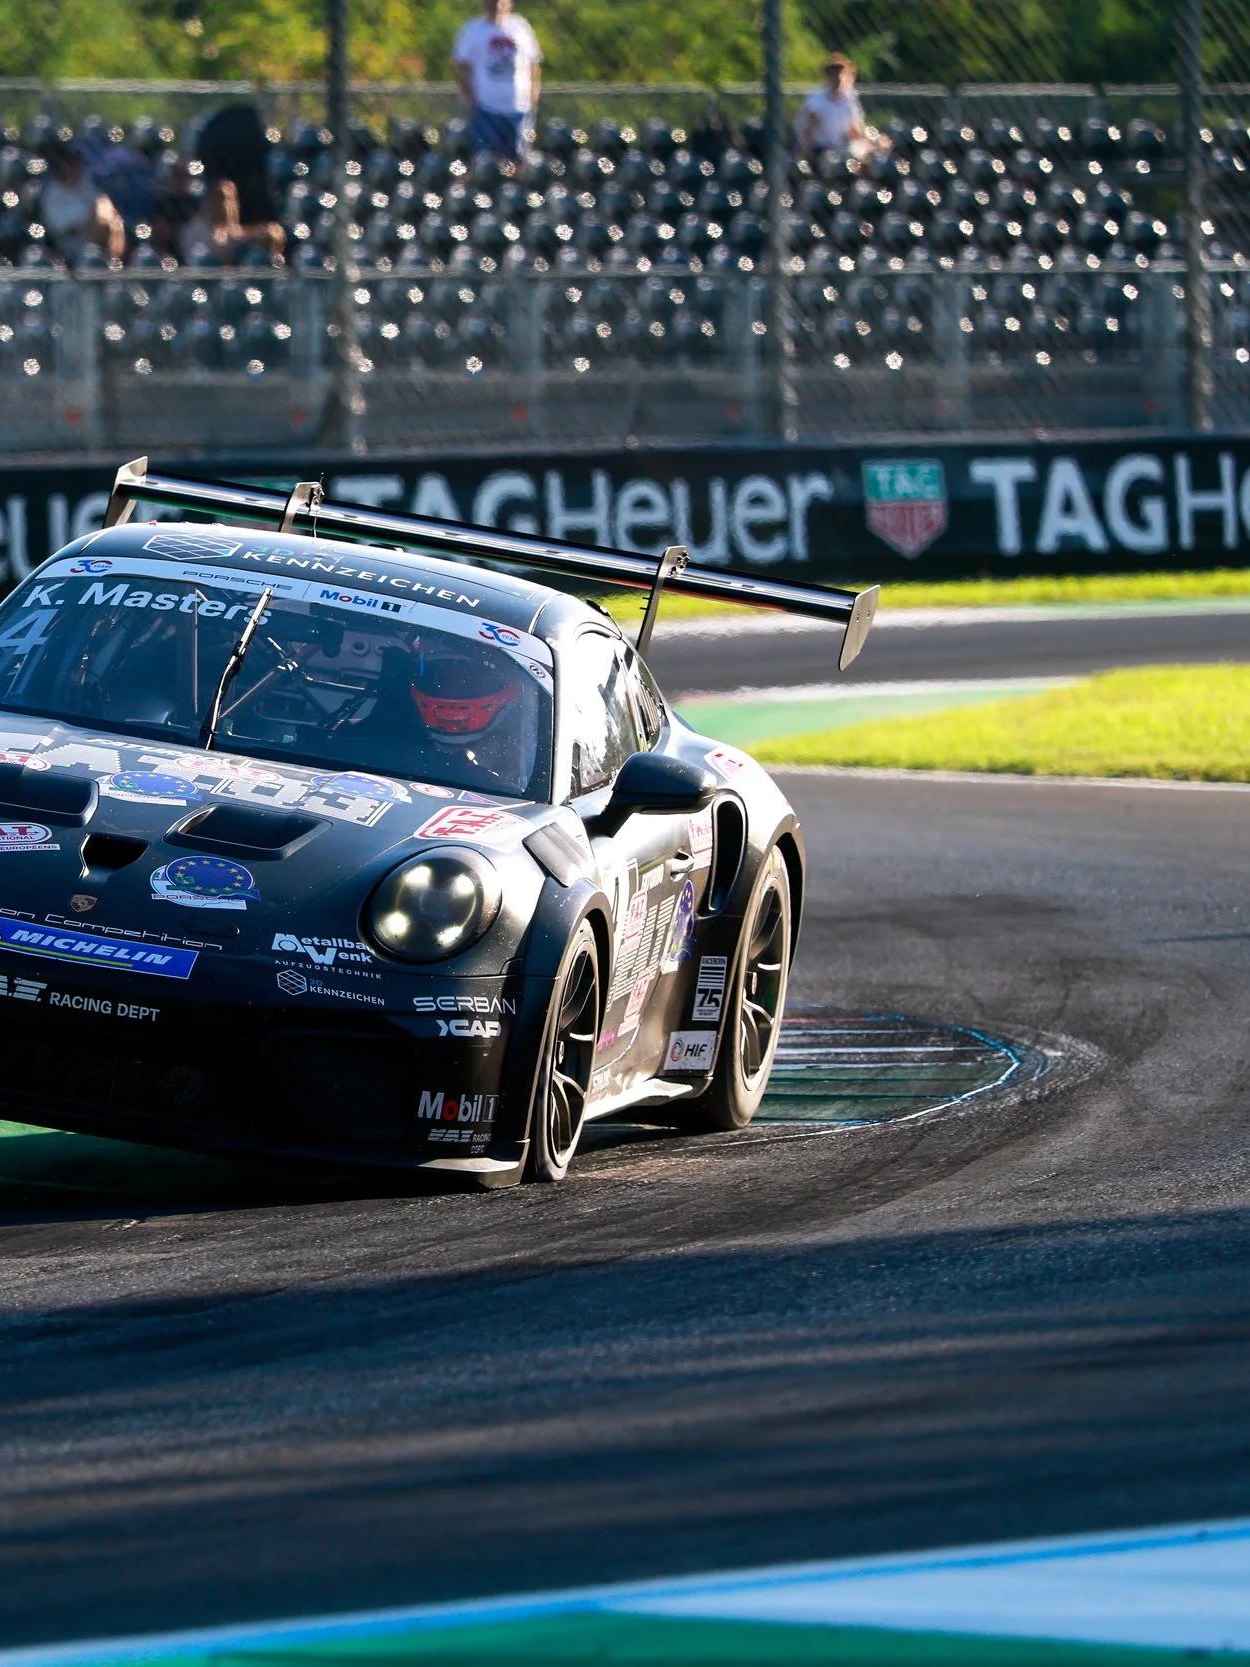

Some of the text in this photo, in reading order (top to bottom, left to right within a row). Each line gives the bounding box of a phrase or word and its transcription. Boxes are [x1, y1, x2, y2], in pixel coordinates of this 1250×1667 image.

[969, 452, 1250, 556] TAGH
[182, 570, 293, 590] PORSCHE
[242, 551, 480, 608] KENNZEICHEN
[22, 582, 272, 626] K. Masters
[319, 589, 378, 608] Mobil
[44, 913, 222, 950] Competition
[10, 929, 173, 965] MICHELIN
[304, 946, 373, 965] Wenk
[275, 960, 382, 979] AUFZUGSTECHNIK
[309, 986, 385, 1006] KENNZEICHEN
[413, 996, 516, 1015] SERBAN
[697, 988, 723, 1008] 75
[49, 992, 113, 1014] RACING
[117, 1003, 160, 1022] DEPT
[684, 1044, 708, 1057] HIF
[417, 1090, 483, 1122] Mobil
